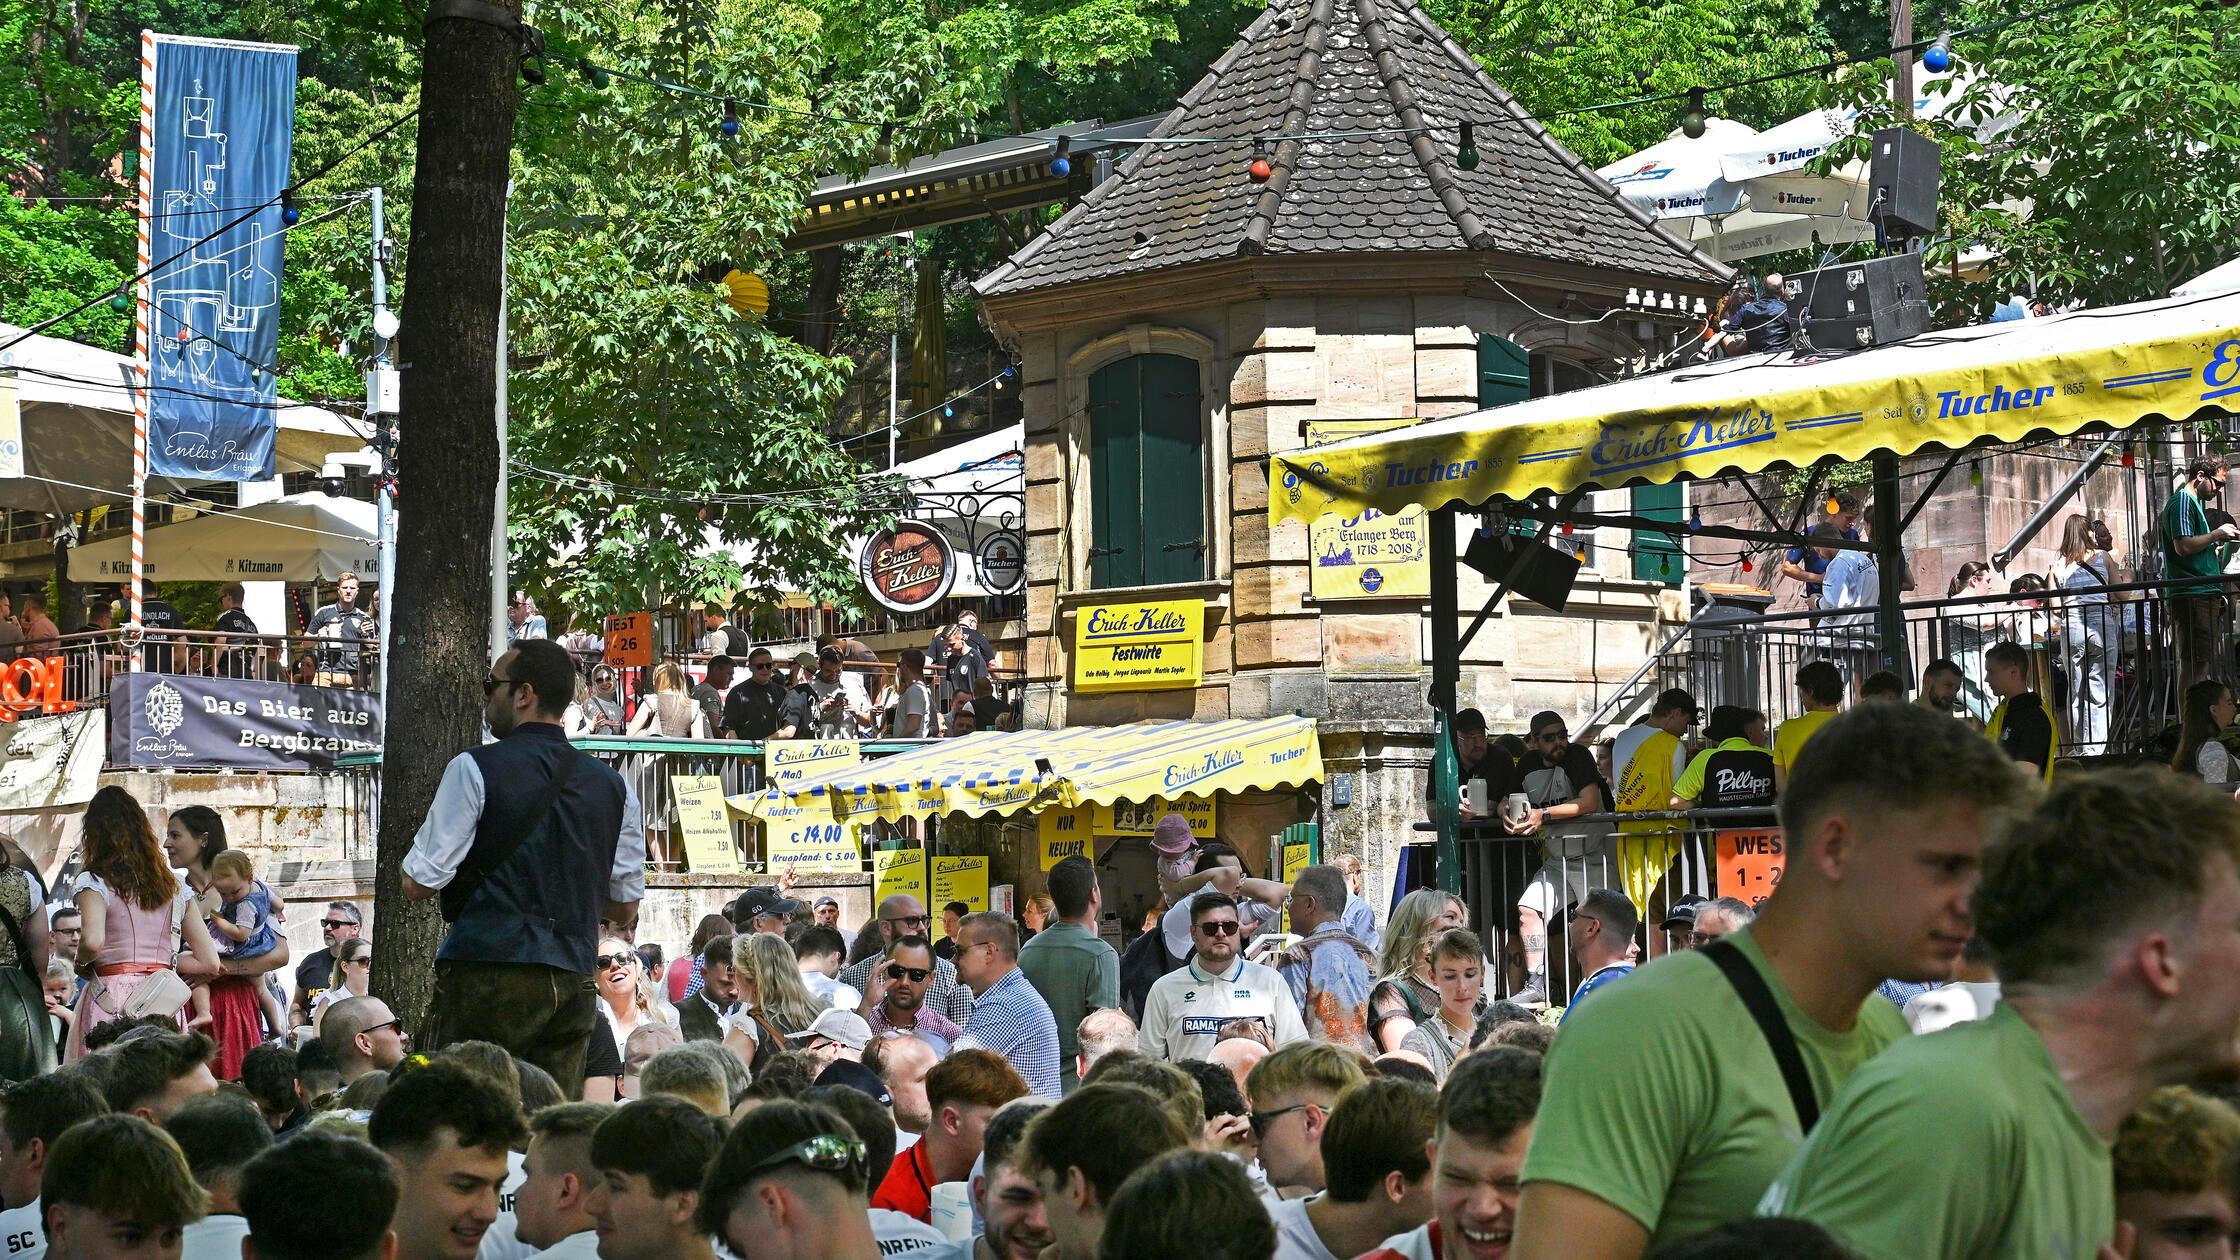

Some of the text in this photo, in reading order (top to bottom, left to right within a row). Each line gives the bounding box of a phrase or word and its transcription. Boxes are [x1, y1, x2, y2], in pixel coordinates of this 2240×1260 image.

[1778, 148, 1820, 163] Tucher
[1668, 197, 1705, 209] Tucher
[1786, 193, 1816, 205] Tucher
[1883, 382, 2085, 419] Seit Tucher 1855
[1590, 405, 1775, 466] Erich-Keller
[1385, 457, 1479, 488] Tucher
[1485, 458, 1503, 469] 1855
[1398, 515, 1415, 526] am
[1340, 528, 1417, 543] Erlanger Berg
[1357, 544, 1378, 555] 1718
[1388, 542, 1413, 555] 2018
[876, 549, 917, 567] Erich-
[987, 560, 1018, 568] Tucher
[112, 560, 156, 574] Kitznn
[238, 559, 283, 573] Kitzmann
[890, 564, 941, 588] Keller
[1087, 607, 1186, 634] Erich-Keller
[620, 637, 637, 651] 26
[1112, 644, 1162, 661] Festwirte
[611, 656, 625, 666] SOS
[1085, 669, 1094, 678] Udo
[202, 695, 369, 726] Das Bier aus
[6, 739, 34, 757] der
[774, 743, 850, 763] Erich-Keller
[781, 769, 803, 779] Maß
[1164, 747, 1306, 787] Erich-Keller Tucher
[1715, 768, 1772, 794] Pillipp
[979, 788, 1031, 806] Erich-Keller
[1629, 784, 1648, 801] liebe
[680, 797, 702, 806] Weizen
[1167, 801, 1212, 814] Sarti Spritz
[767, 806, 804, 817] Tucher
[1056, 815, 1075, 831] NUR
[790, 832, 800, 844] €
[1048, 840, 1085, 857] KELLNER
[825, 852, 833, 861] €
[879, 852, 921, 869] Erich-Keller
[937, 857, 983, 872] Erich-Keller
[1736, 867, 1746, 887] 1
[1770, 866, 1782, 886] 2
[751, 904, 763, 914] 60
[6, 1230, 36, 1254] SC
